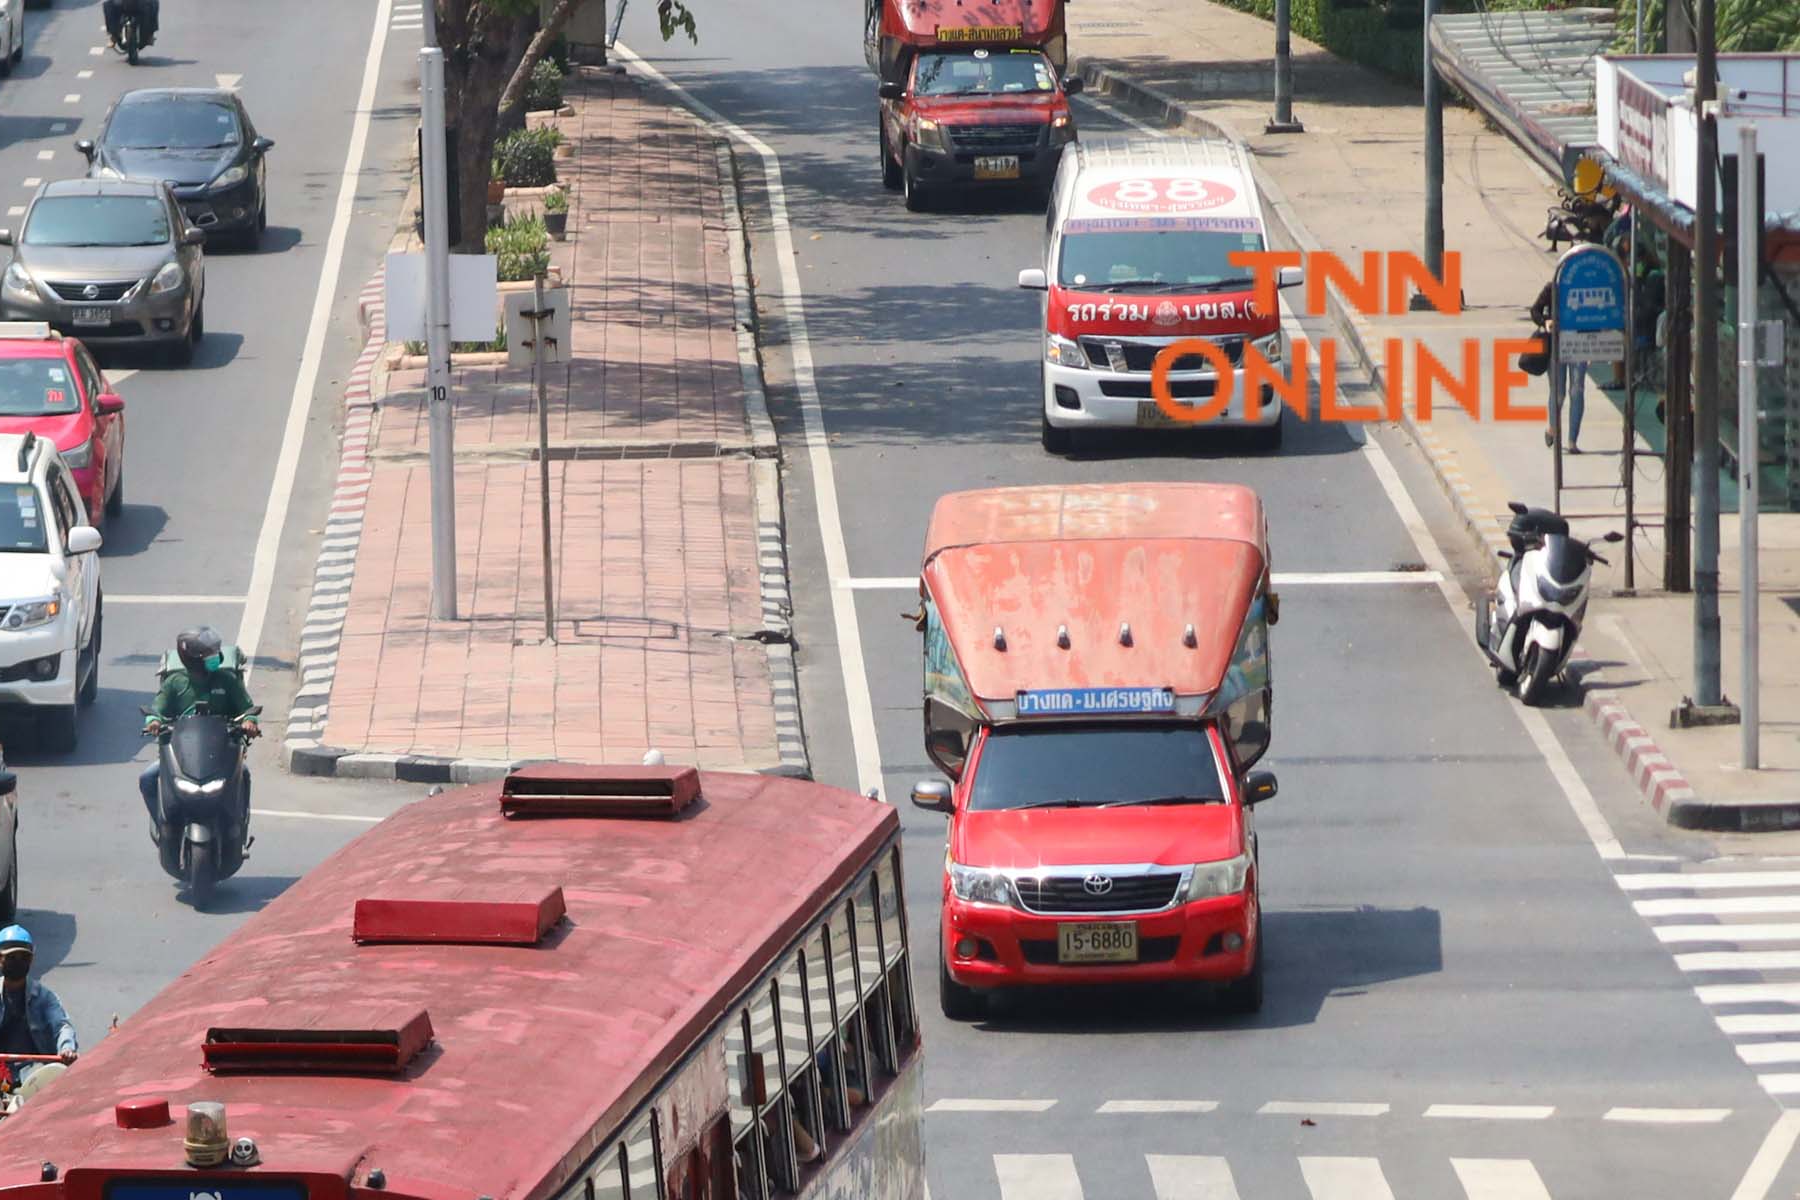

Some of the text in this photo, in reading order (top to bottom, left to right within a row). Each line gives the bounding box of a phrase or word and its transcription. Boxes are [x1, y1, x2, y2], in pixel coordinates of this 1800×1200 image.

[1115, 178, 1208, 203] 88
[1067, 298, 1149, 322] รถร่วม
[431, 385, 447, 401] 10
[1066, 931, 1132, 951] 15-6880
